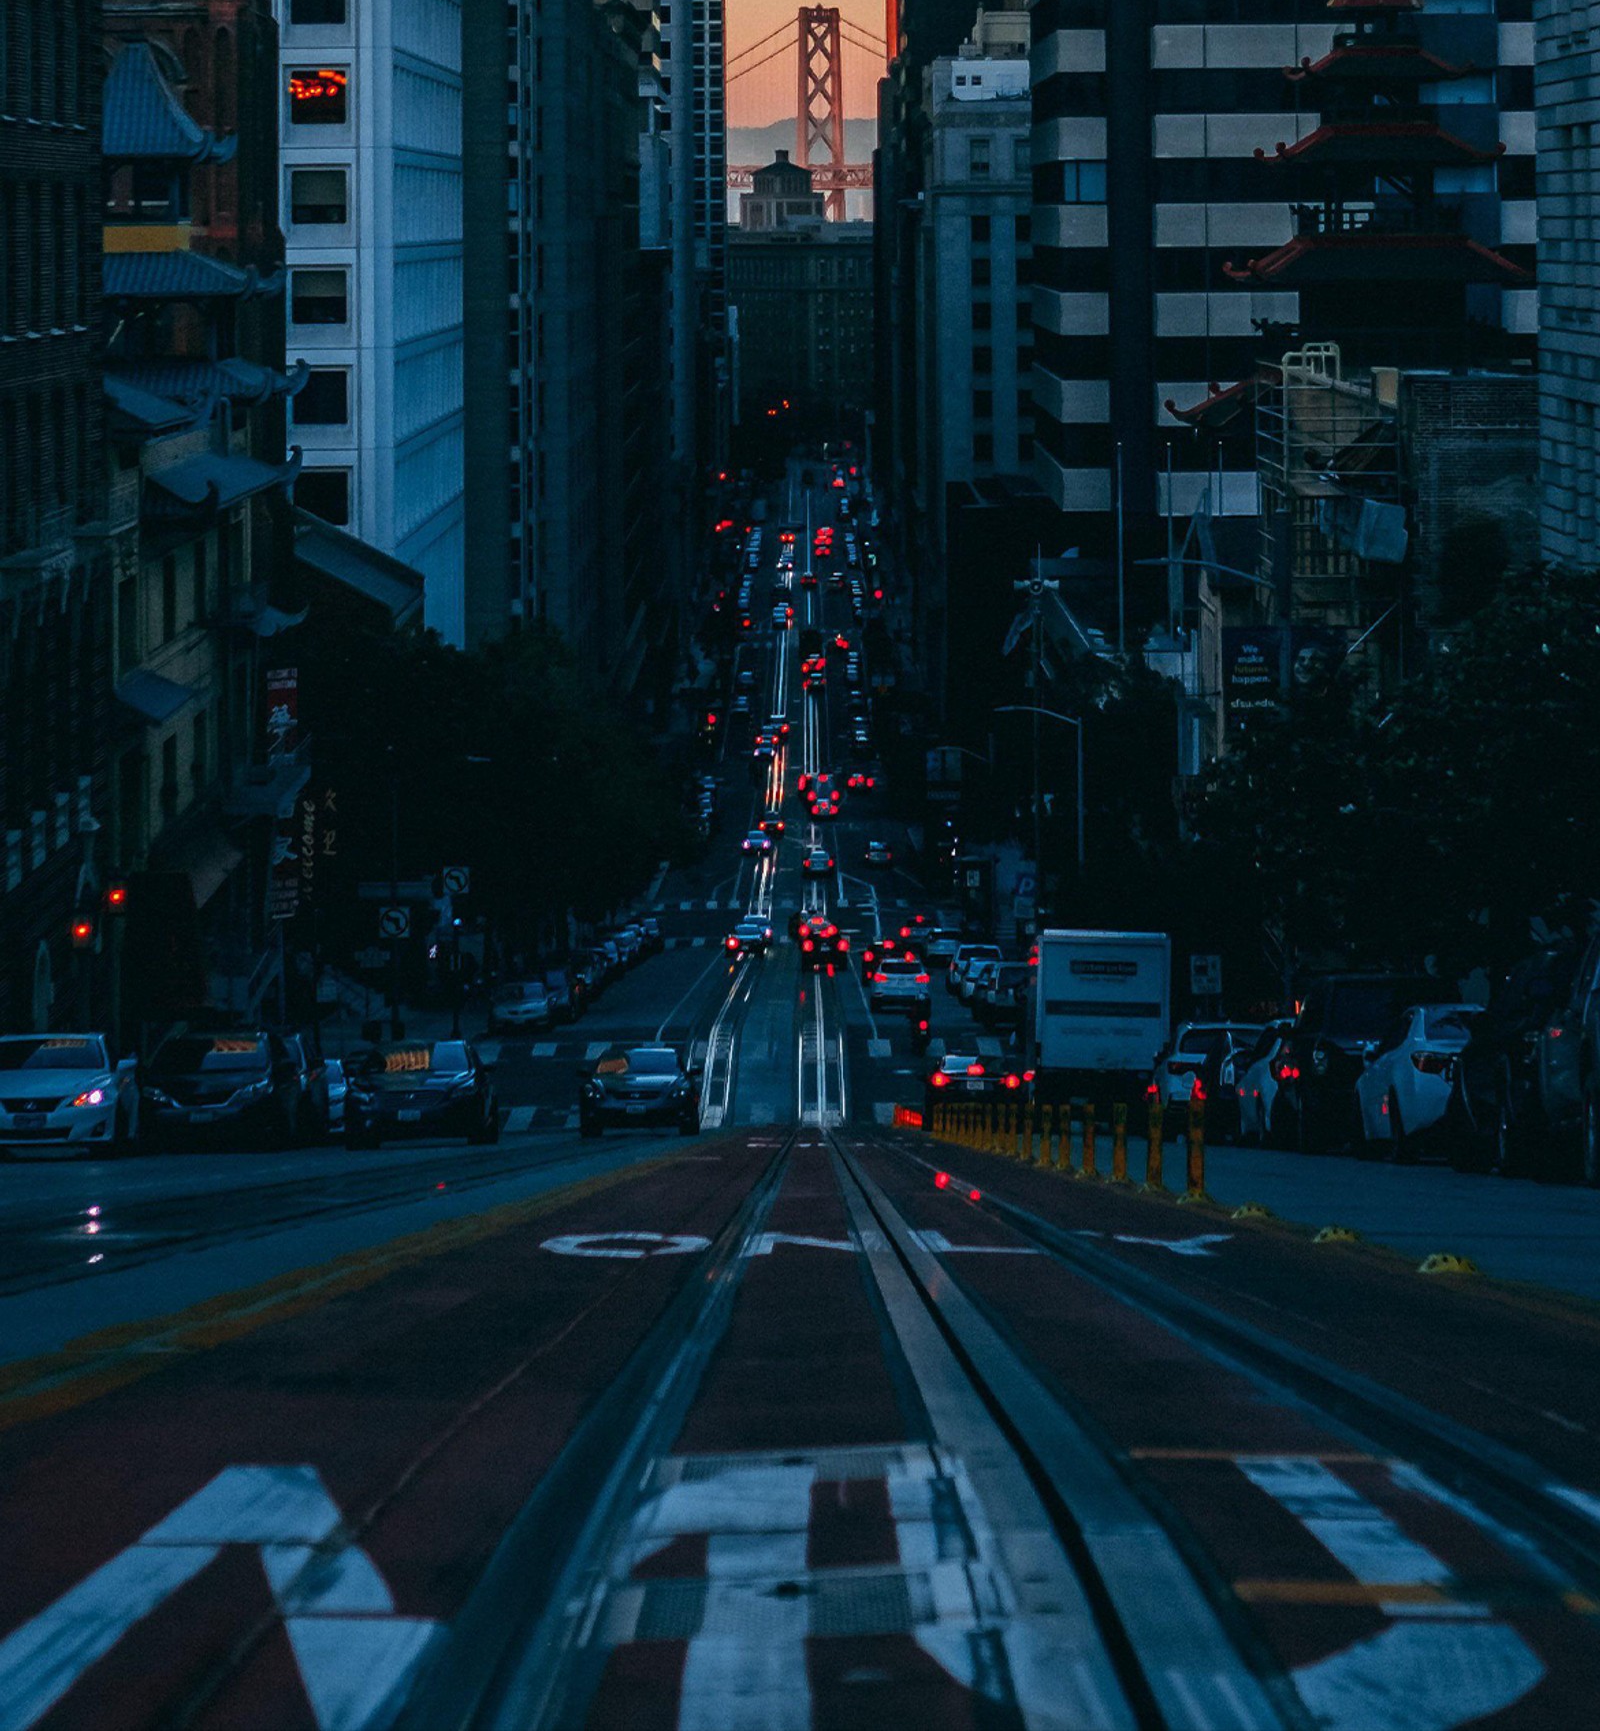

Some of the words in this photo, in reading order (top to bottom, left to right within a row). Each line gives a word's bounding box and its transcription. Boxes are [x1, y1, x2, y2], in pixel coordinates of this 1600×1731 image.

[1241, 644, 1259, 654] We
[1237, 655, 1265, 664] make
[1231, 674, 1271, 685] happen.
[539, 1230, 1236, 1260] ONLY
